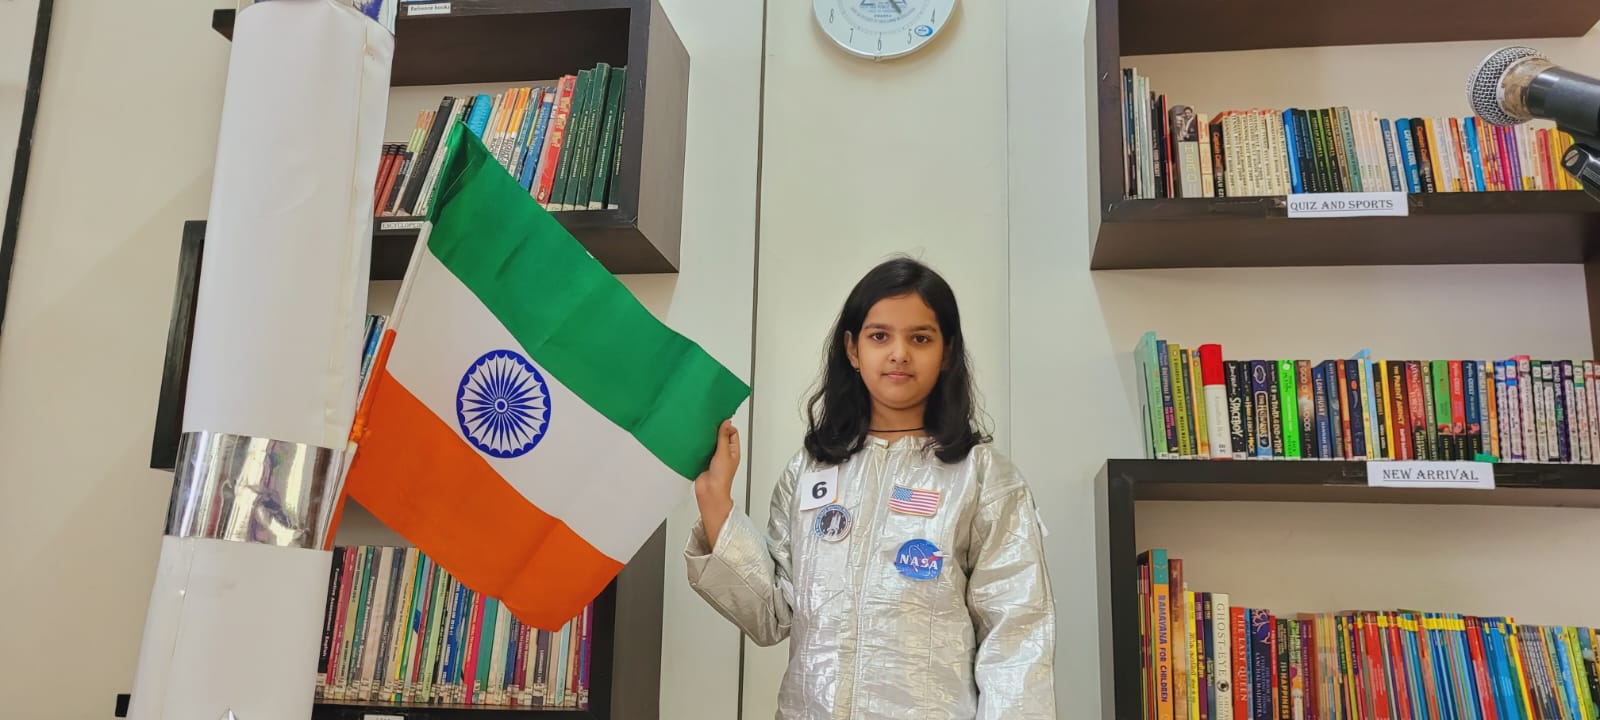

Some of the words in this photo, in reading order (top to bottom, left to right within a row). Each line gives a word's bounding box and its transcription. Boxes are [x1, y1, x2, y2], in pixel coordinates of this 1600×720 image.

[829, 8, 834, 24] 8
[931, 8, 936, 24] 4
[849, 28, 854, 44] 7
[877, 32, 882, 51] 6
[907, 28, 912, 44] 5
[1290, 201, 1317, 211] QUIZ
[1321, 200, 1345, 210] AND
[1348, 199, 1393, 209] SPORTS
[1229, 397, 1243, 437] SPACEBOY
[1383, 468, 1412, 479] NEW
[1416, 469, 1479, 480] ARRIVAL
[812, 481, 828, 499] 6
[899, 554, 938, 570] NASA
[331, 568, 340, 596] Formative
[326, 597, 336, 631] Assessment
[1158, 595, 1168, 644] RAMAYANA
[1237, 614, 1246, 633] THE
[322, 636, 330, 657] English
[1216, 602, 1227, 676] GHOST-EYE
[1238, 638, 1246, 661] LAST
[1160, 666, 1168, 702] CHILDREN
[1239, 666, 1247, 702] QUEEN
